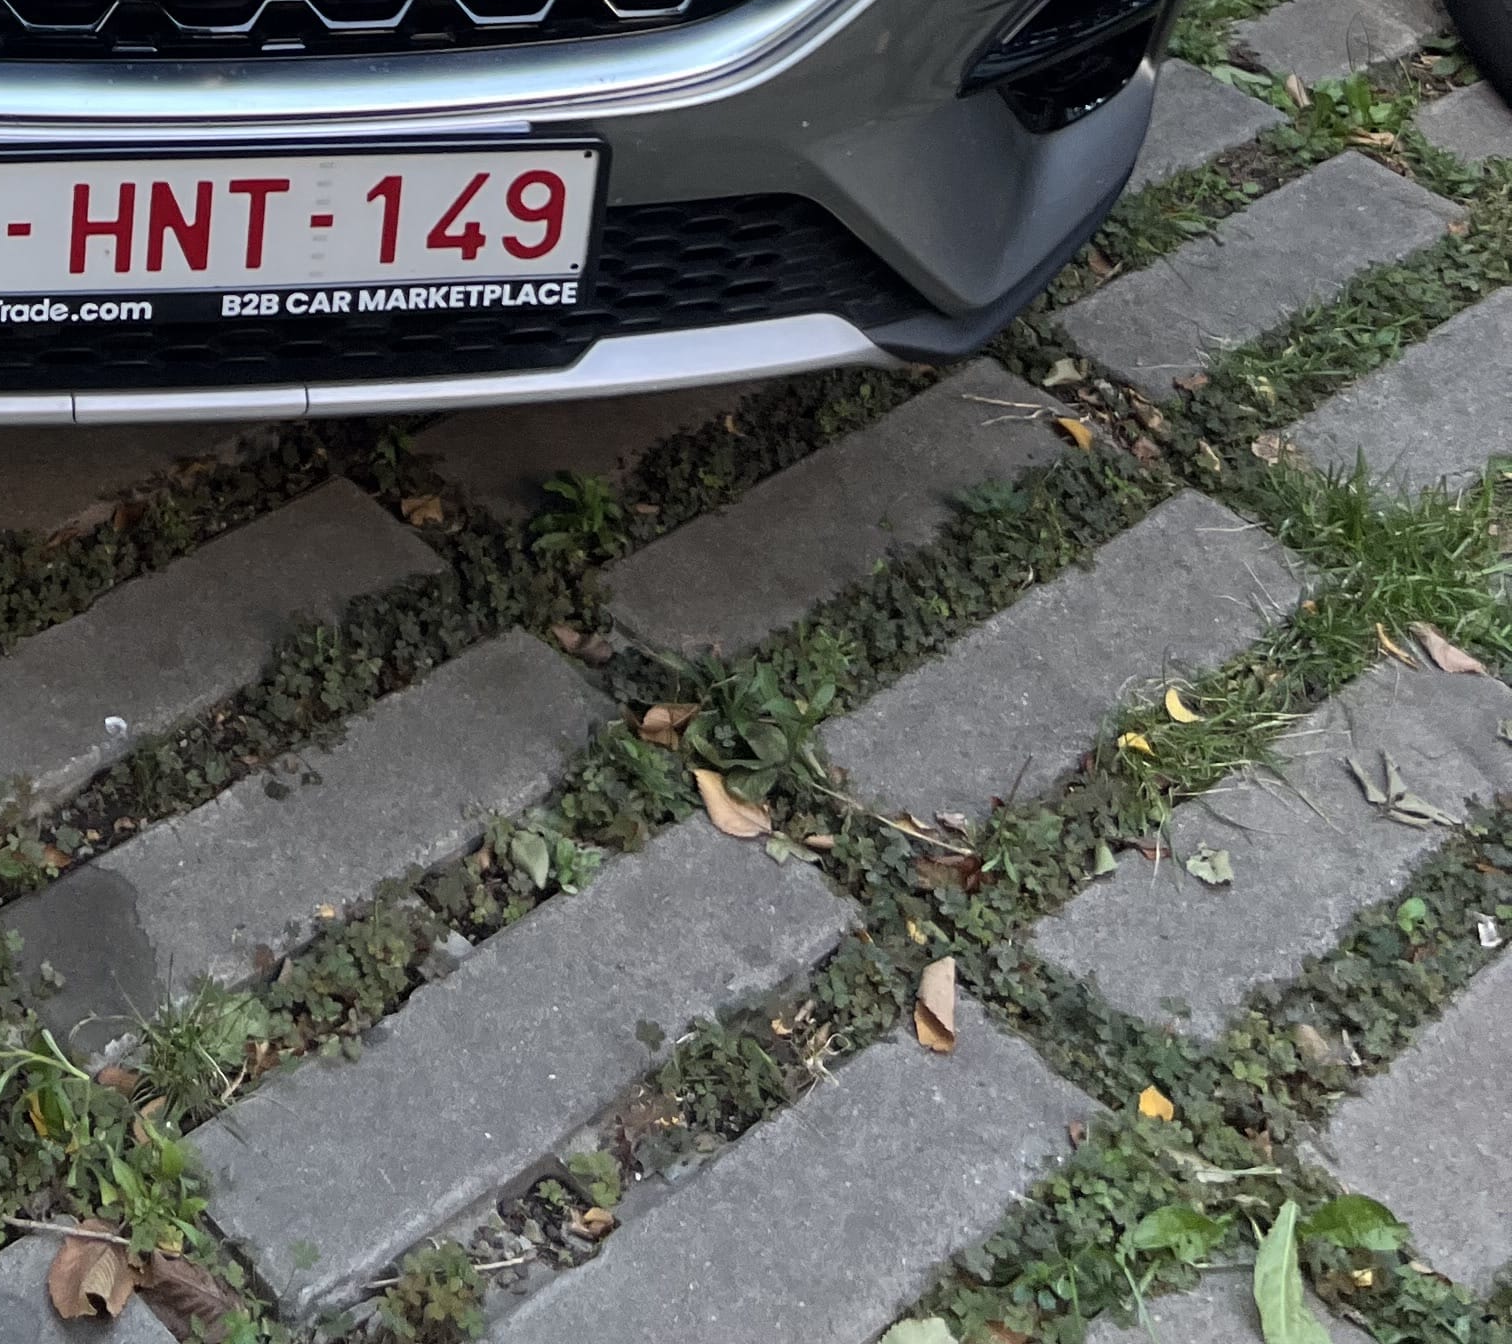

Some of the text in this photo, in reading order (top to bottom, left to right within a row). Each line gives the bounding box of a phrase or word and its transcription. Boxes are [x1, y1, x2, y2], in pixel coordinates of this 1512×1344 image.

[221, 282, 578, 317] B2B CAR MARKETPLACE
